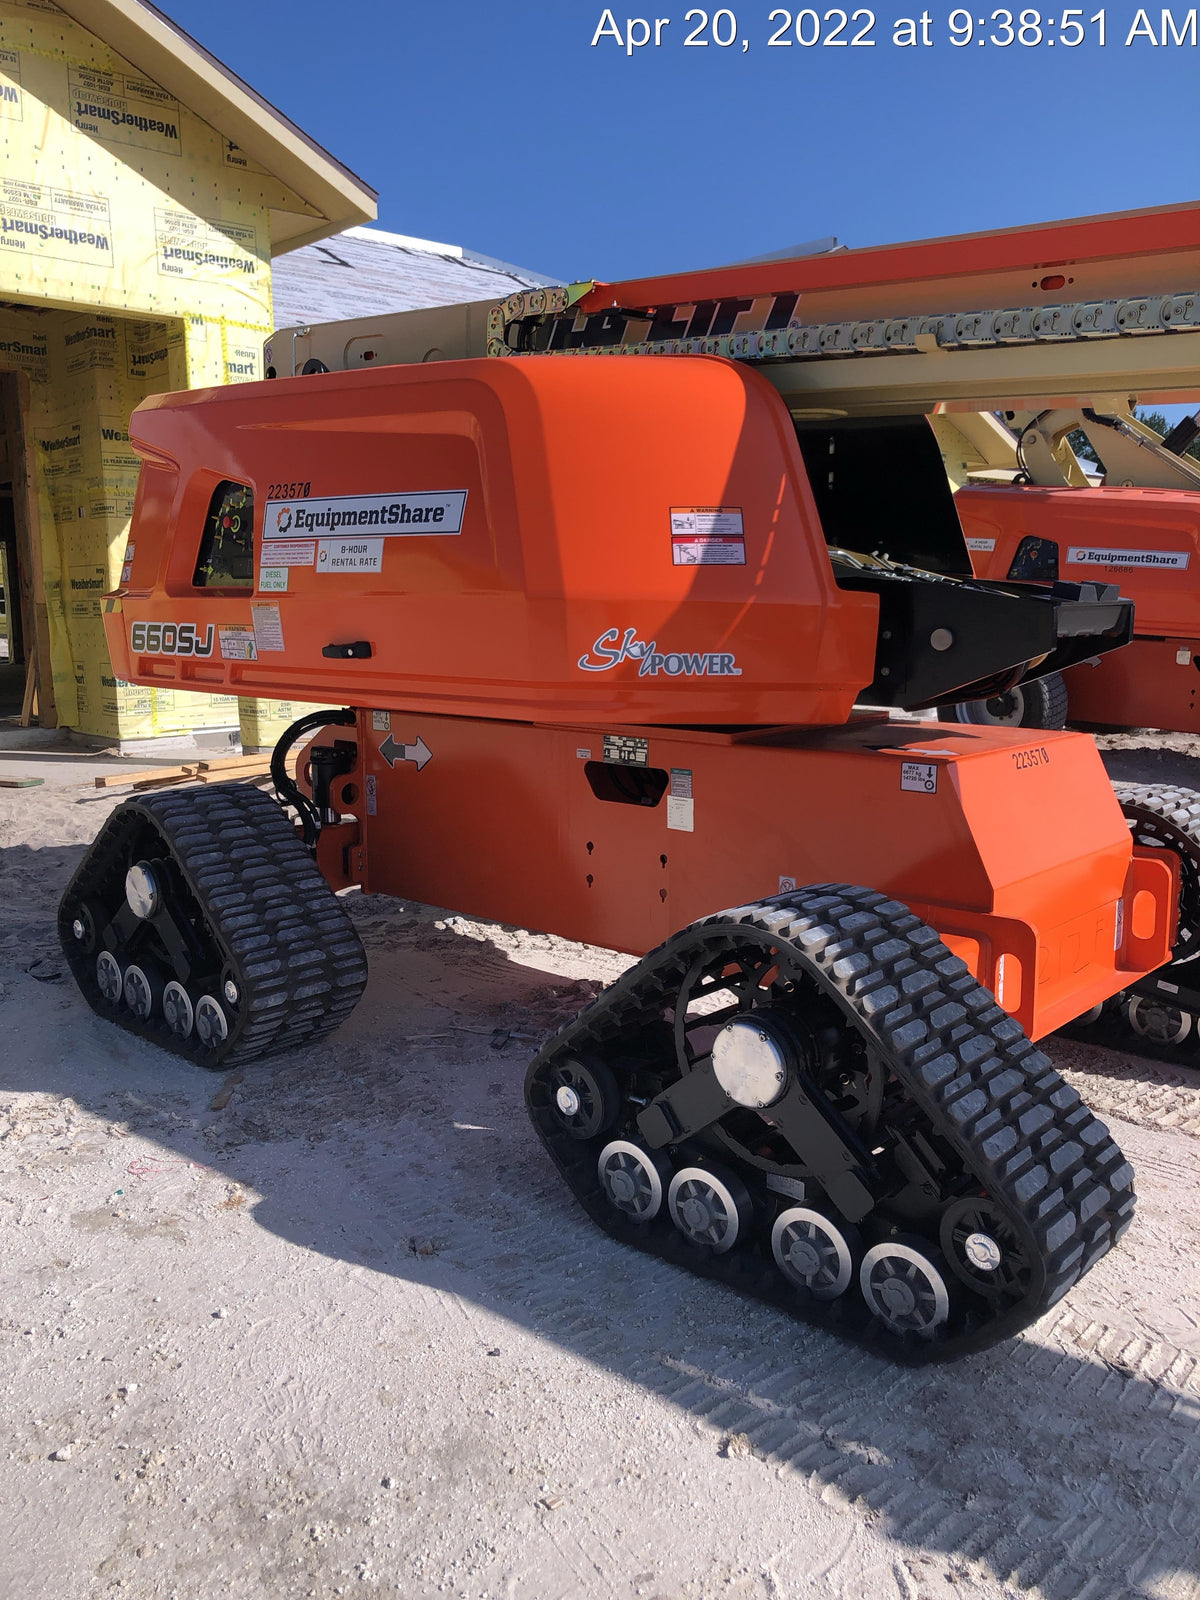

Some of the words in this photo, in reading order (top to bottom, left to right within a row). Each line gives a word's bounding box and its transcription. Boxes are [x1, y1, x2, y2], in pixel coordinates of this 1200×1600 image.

[76, 102, 178, 139] WeatherSmart
[76, 120, 98, 133] Henry
[226, 154, 248, 166] Henry
[54, 197, 84, 208] WARRANTY
[2, 218, 110, 250] WeatherSmart
[0, 236, 26, 249] Henry
[162, 246, 254, 274] WeatherSmart
[162, 263, 184, 274] Henry
[294, 504, 445, 532] EquipmentShare
[341, 545, 368, 554] 8-HOUR
[332, 558, 356, 566] RENTAL
[359, 558, 378, 566] RATE
[1088, 552, 1178, 564] EquipmentShare
[132, 623, 214, 655] 660SJ
